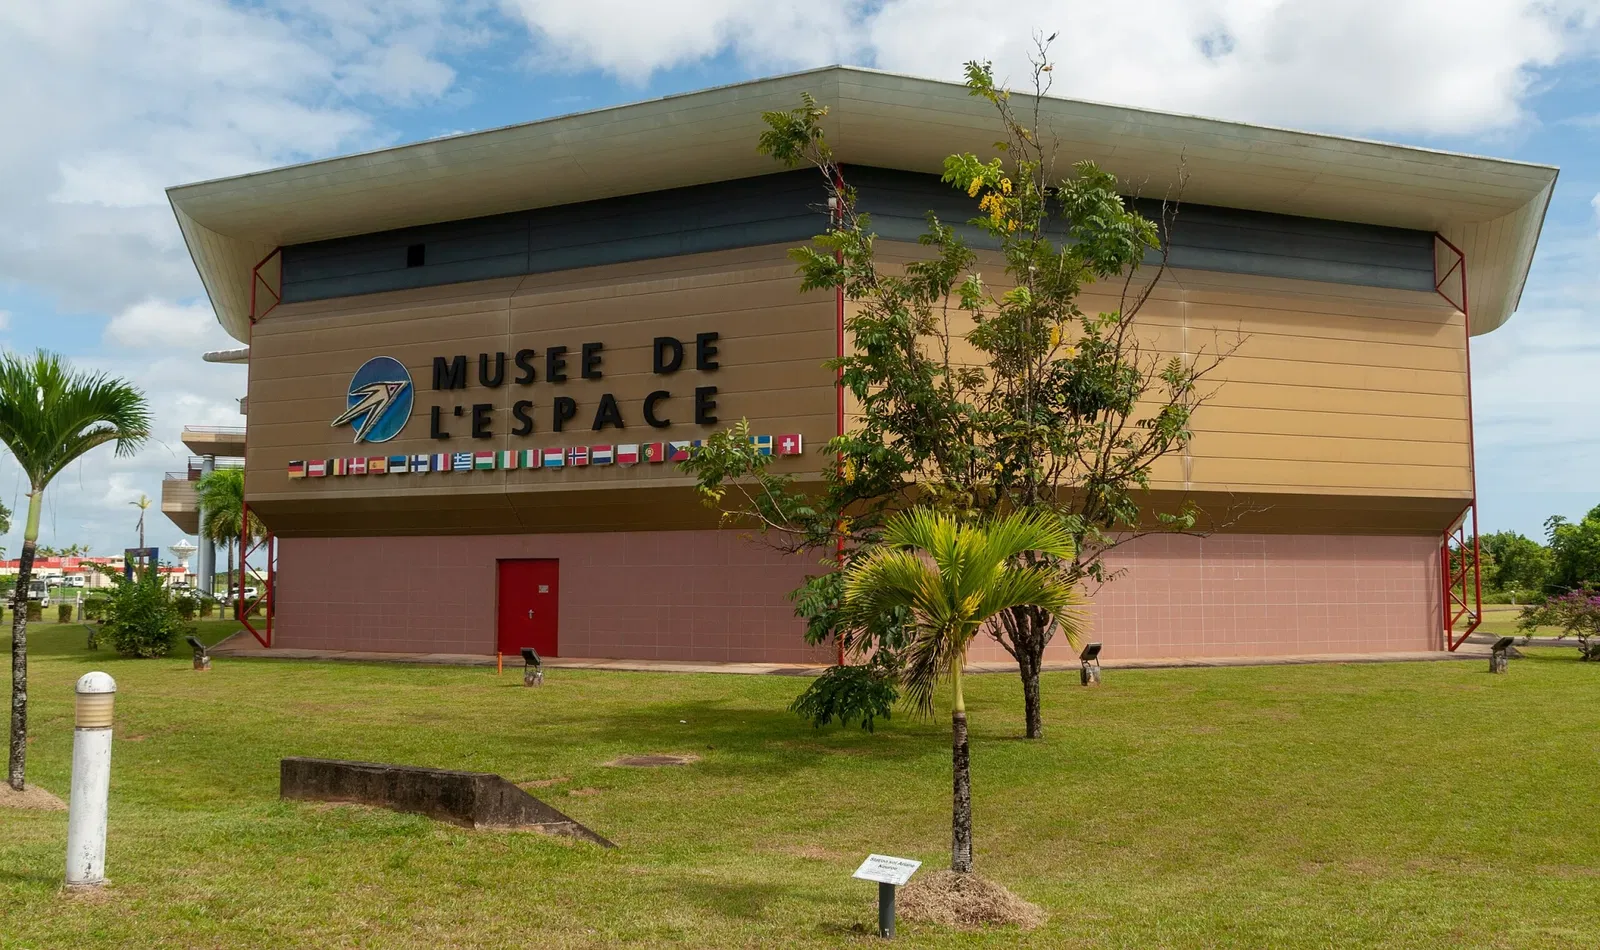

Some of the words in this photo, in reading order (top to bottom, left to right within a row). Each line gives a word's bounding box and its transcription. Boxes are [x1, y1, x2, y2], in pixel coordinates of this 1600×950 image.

[432, 342, 603, 390] MUSEE
[653, 332, 719, 374] DE
[430, 386, 718, 439] L'ESPACE
